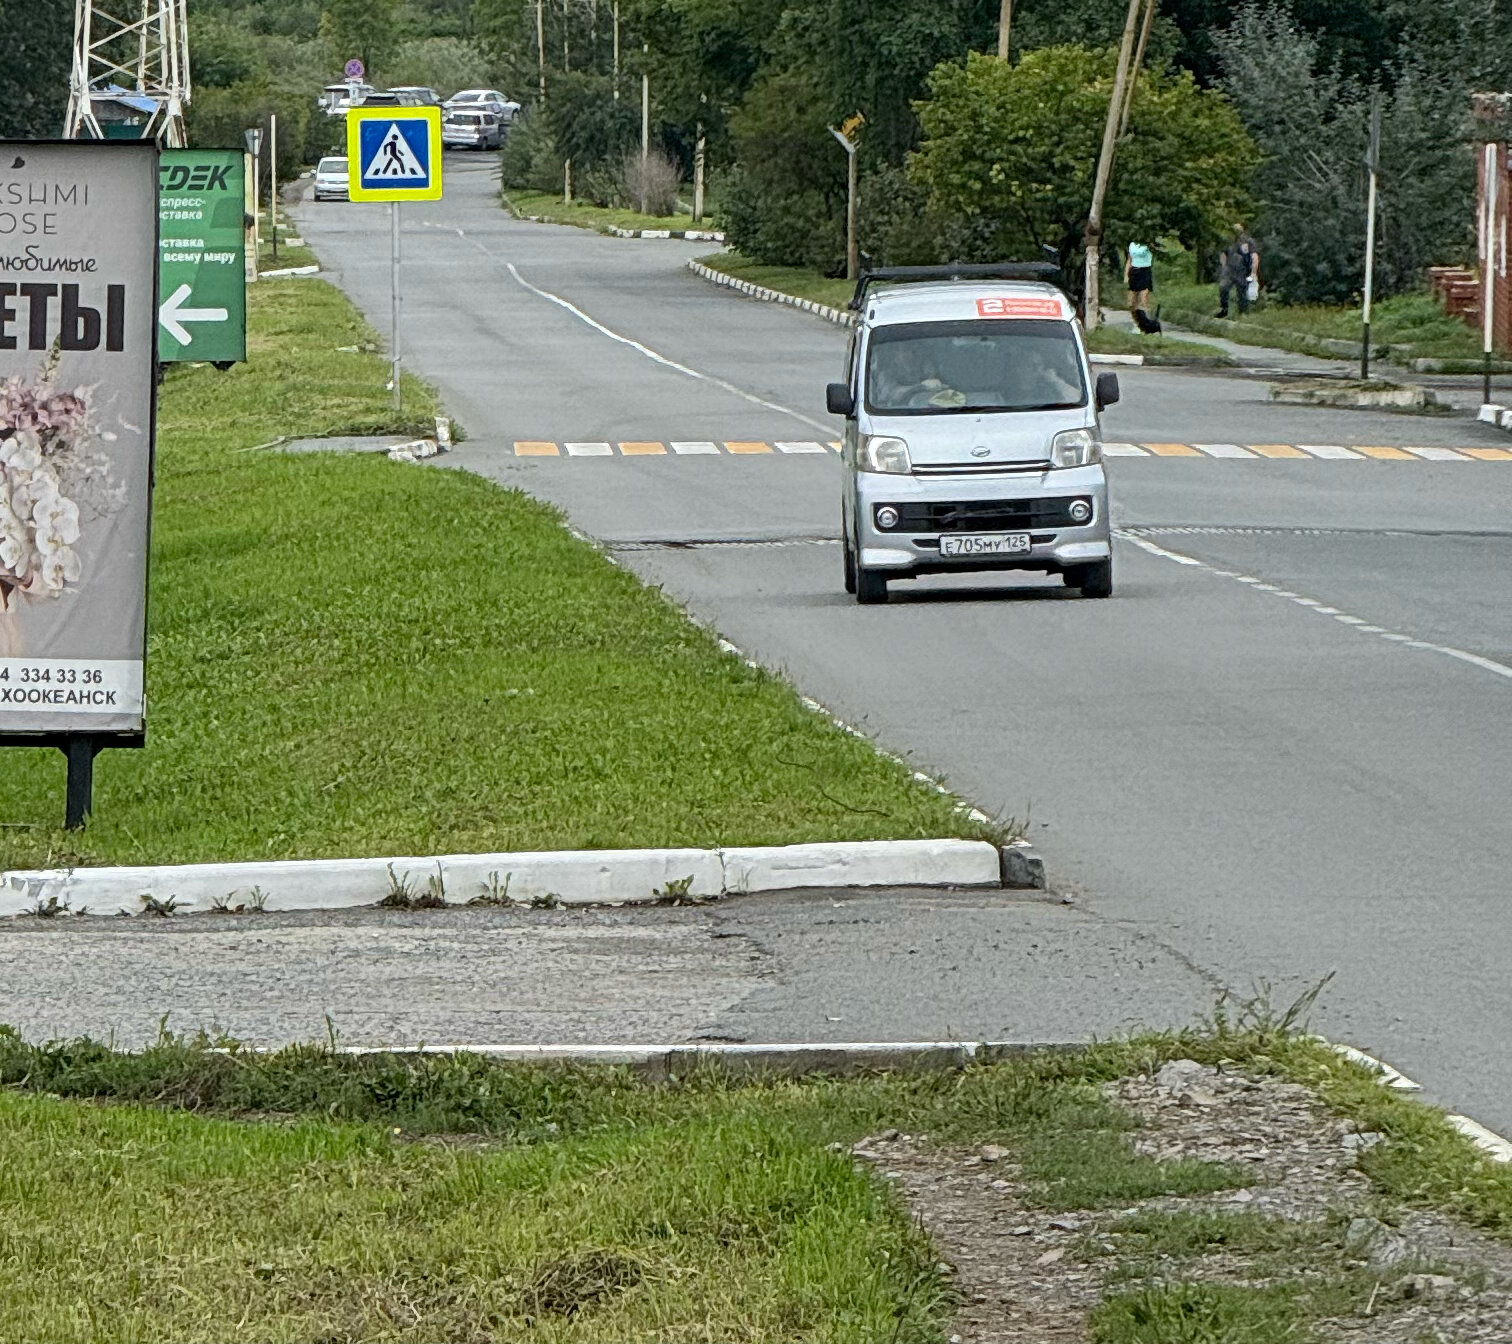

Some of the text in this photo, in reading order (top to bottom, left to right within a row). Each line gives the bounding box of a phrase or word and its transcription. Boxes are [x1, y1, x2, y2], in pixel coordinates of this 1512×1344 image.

[164, 253, 236, 264] всему миру
[20, 668, 51, 683] 334
[56, 669, 77, 683] 33
[82, 670, 103, 684] 36
